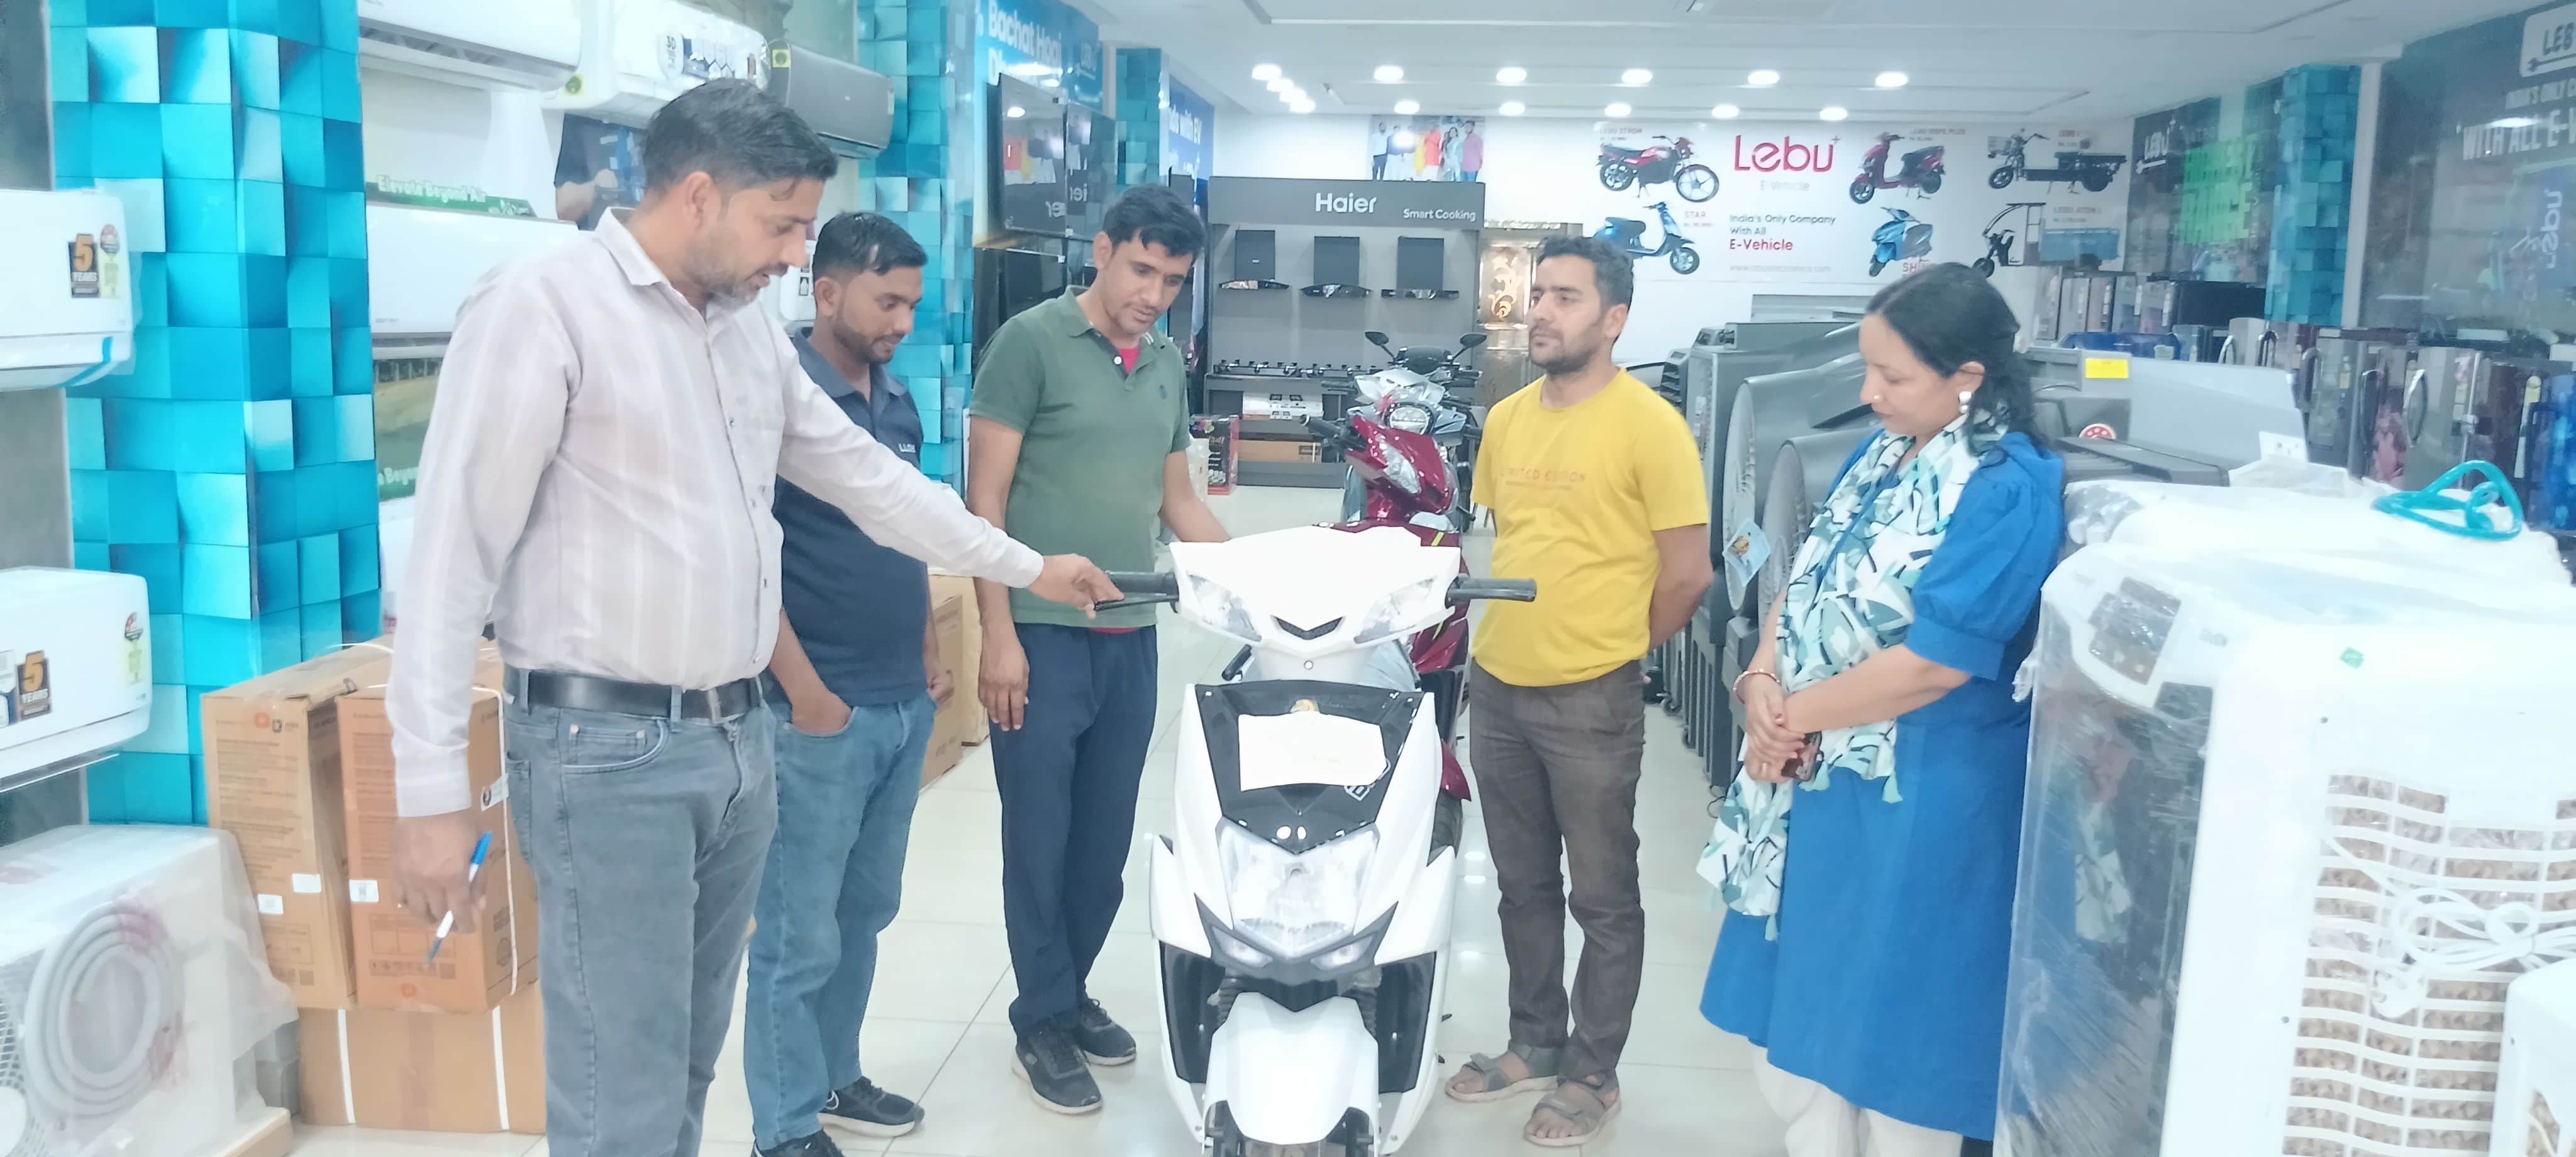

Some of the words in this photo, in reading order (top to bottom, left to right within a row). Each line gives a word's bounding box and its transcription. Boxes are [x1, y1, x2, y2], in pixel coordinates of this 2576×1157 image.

[989, 0, 1035, 56] Bachat
[2508, 113, 2541, 153] ALL
[1734, 135, 1834, 172] Lebu
[1315, 192, 1377, 213] Haier
[1403, 208, 1435, 219] Smart
[1435, 209, 1476, 222] Cooking
[1729, 214, 1762, 223] India's
[1765, 214, 1787, 224] Only
[1789, 214, 1836, 225] Company
[1729, 227, 1753, 235] With
[1754, 227, 1767, 235] All
[73, 233, 94, 272] 5
[1729, 238, 1794, 251] E-Vehicle
[23, 649, 44, 692] 5
[21, 688, 49, 704] YEARS
